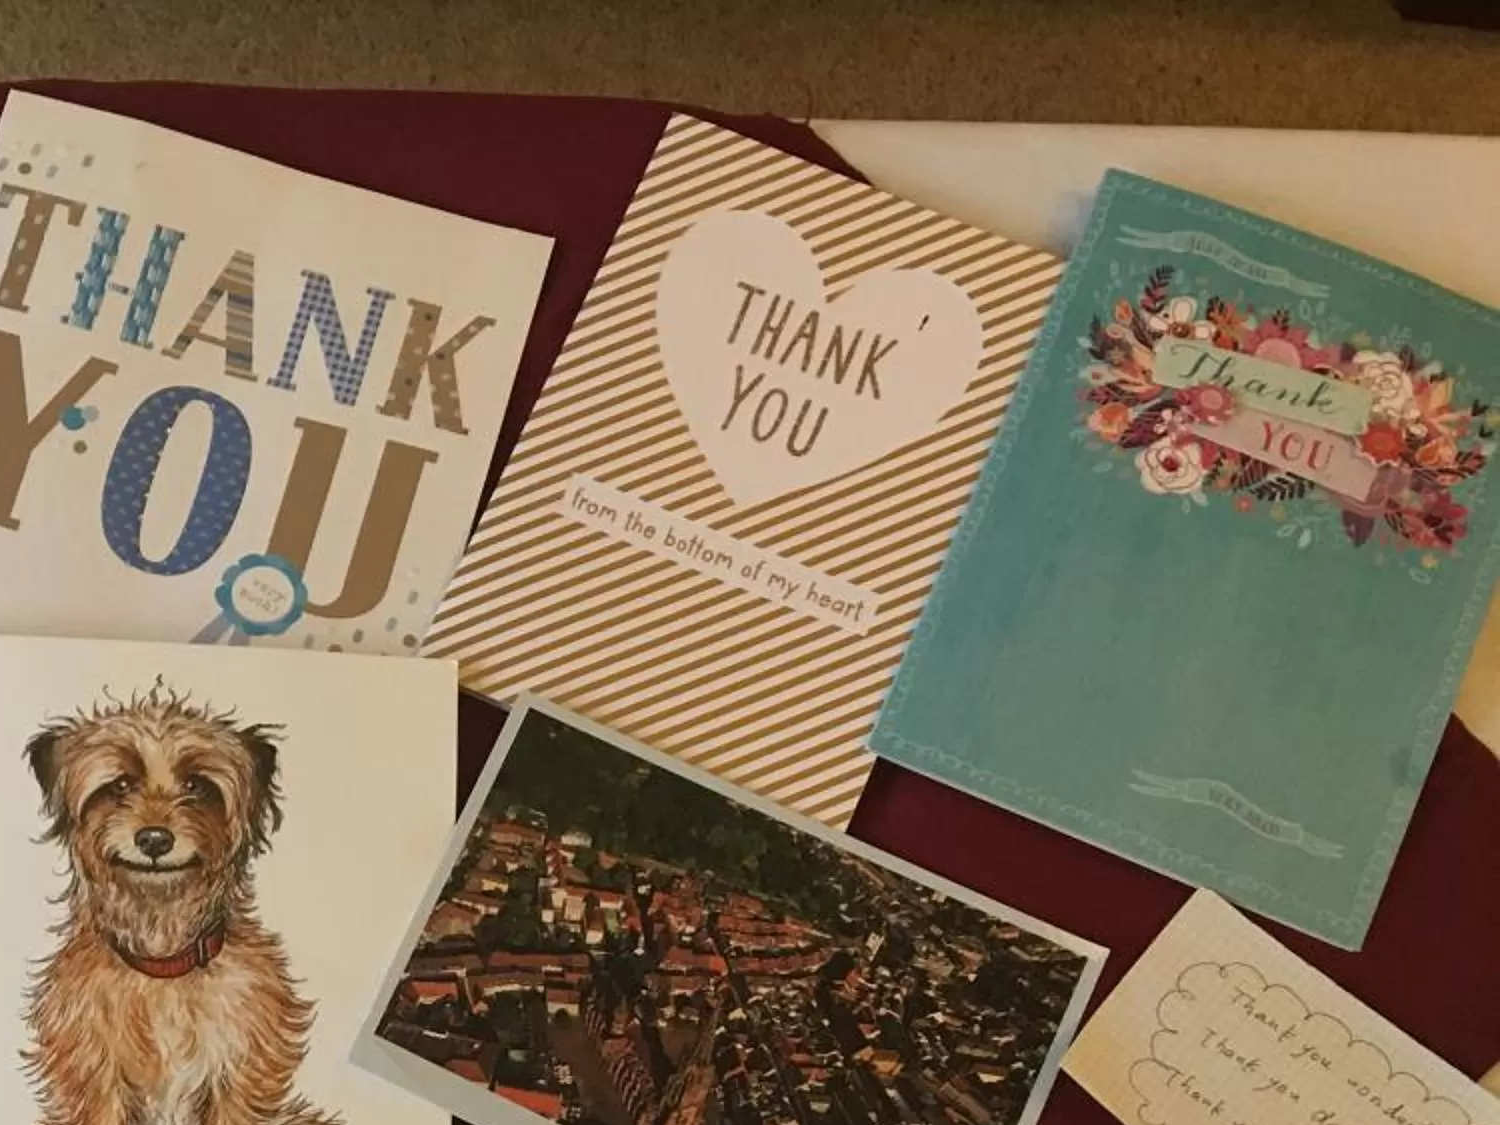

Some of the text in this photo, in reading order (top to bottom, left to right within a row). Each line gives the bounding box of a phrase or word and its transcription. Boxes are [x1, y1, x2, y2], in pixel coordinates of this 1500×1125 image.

[727, 280, 899, 401] THANK
[1170, 343, 1346, 416] Thank
[720, 364, 829, 458] YOU
[1259, 421, 1336, 472] YOU
[571, 487, 866, 622] from the bottom of my heart
[1199, 1027, 1262, 1073] Thank
[1251, 1077, 1301, 1105] you
[1231, 984, 1297, 1044] Thank
[1288, 1043, 1333, 1072] you
[1164, 1065, 1226, 1117] Thank
